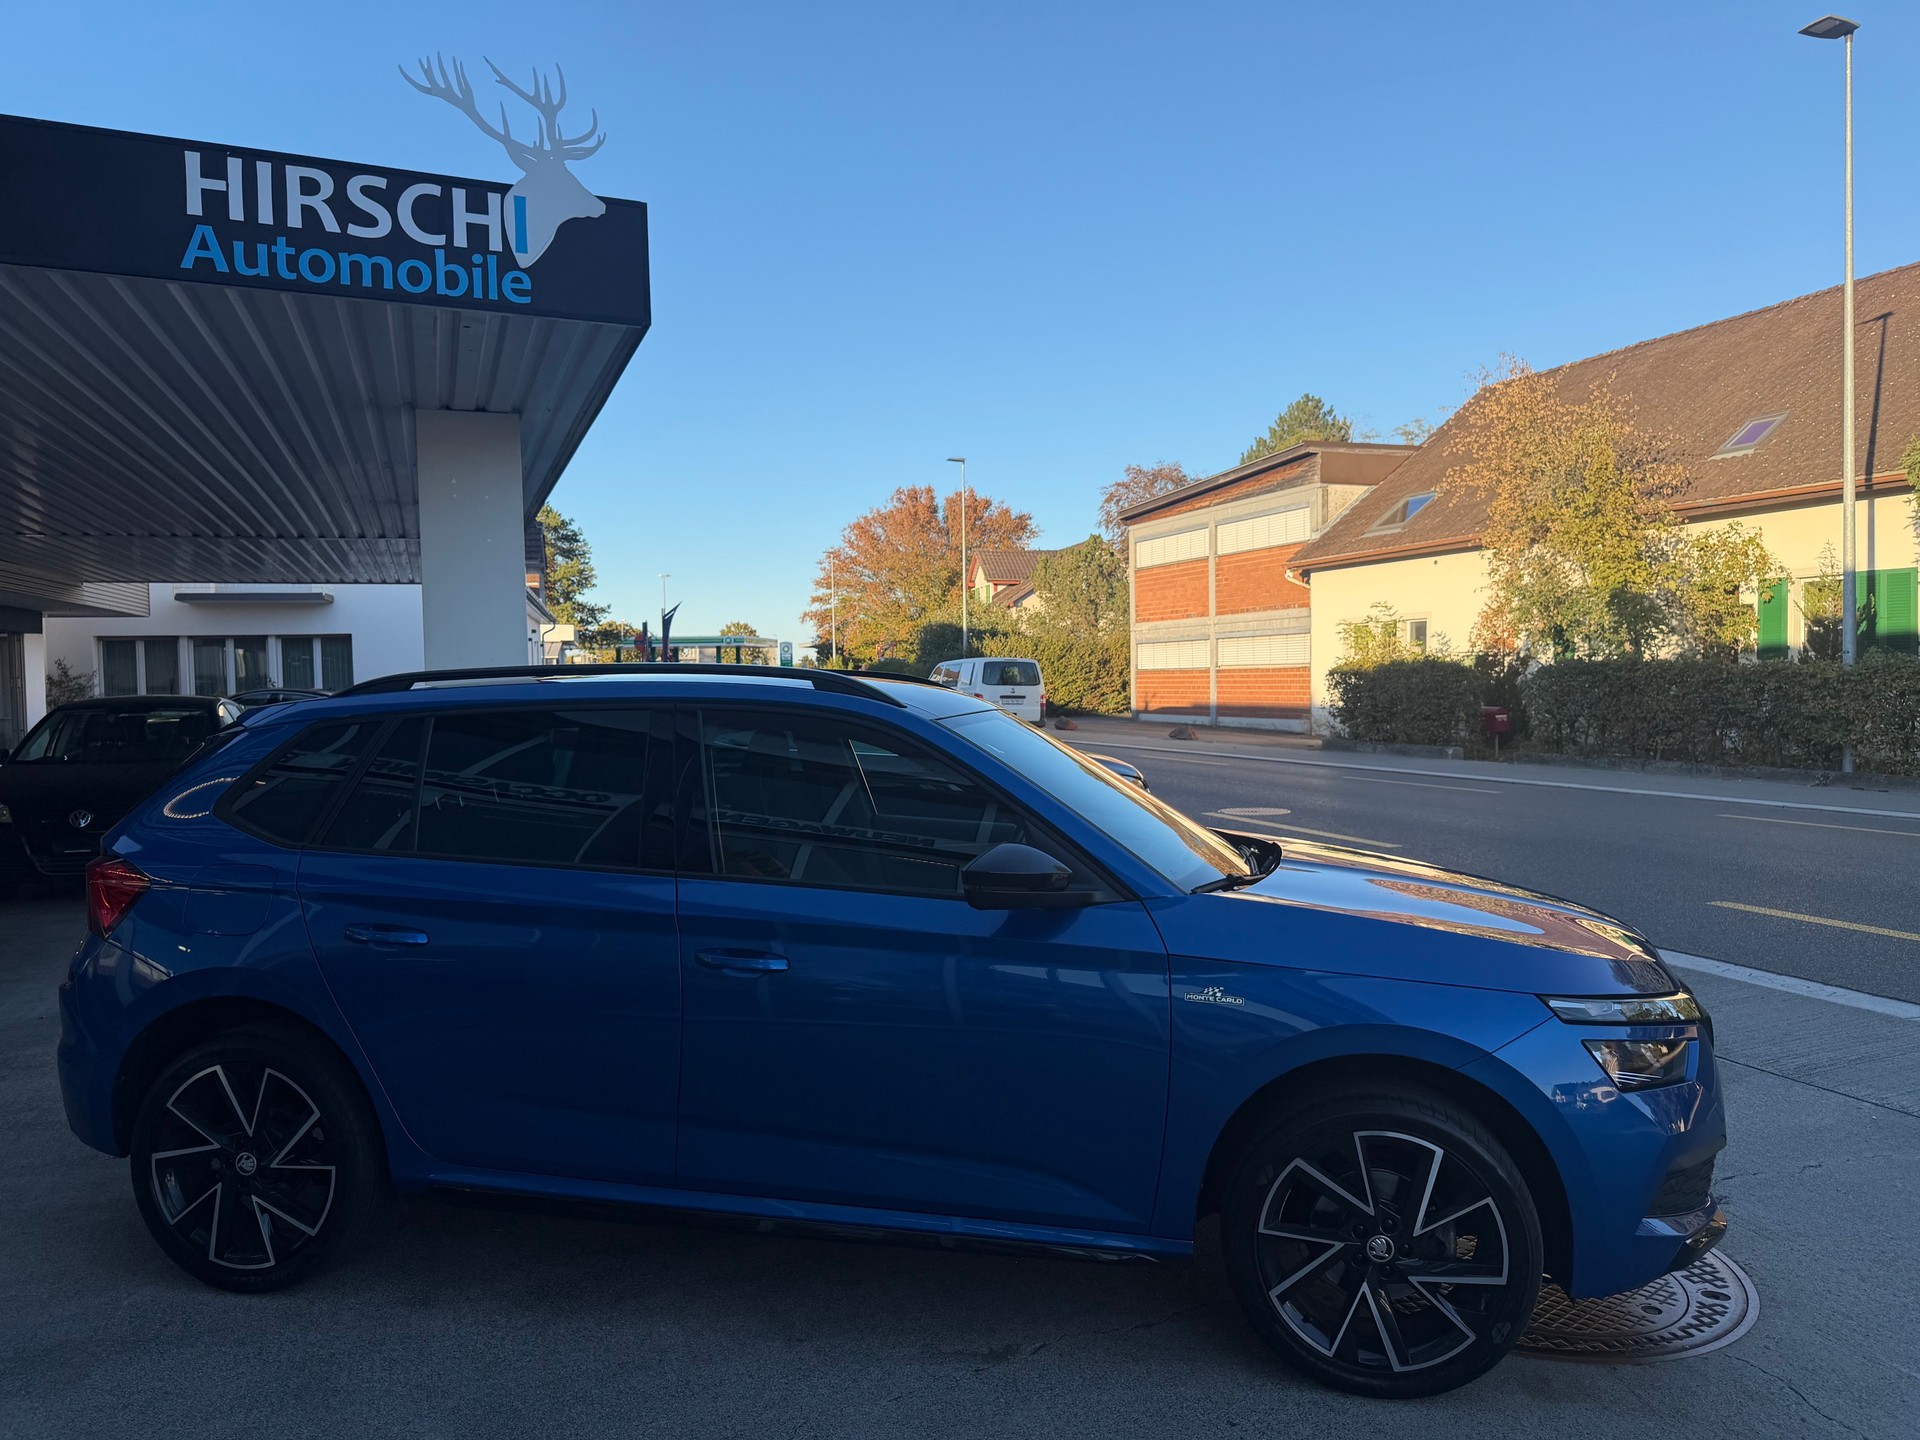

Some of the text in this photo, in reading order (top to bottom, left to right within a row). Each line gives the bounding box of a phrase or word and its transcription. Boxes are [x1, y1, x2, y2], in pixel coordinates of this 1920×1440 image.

[184, 150, 503, 252] HIRSCH
[180, 223, 532, 304] Automobile
[1186, 993, 1243, 1004] MONTE CARLO
